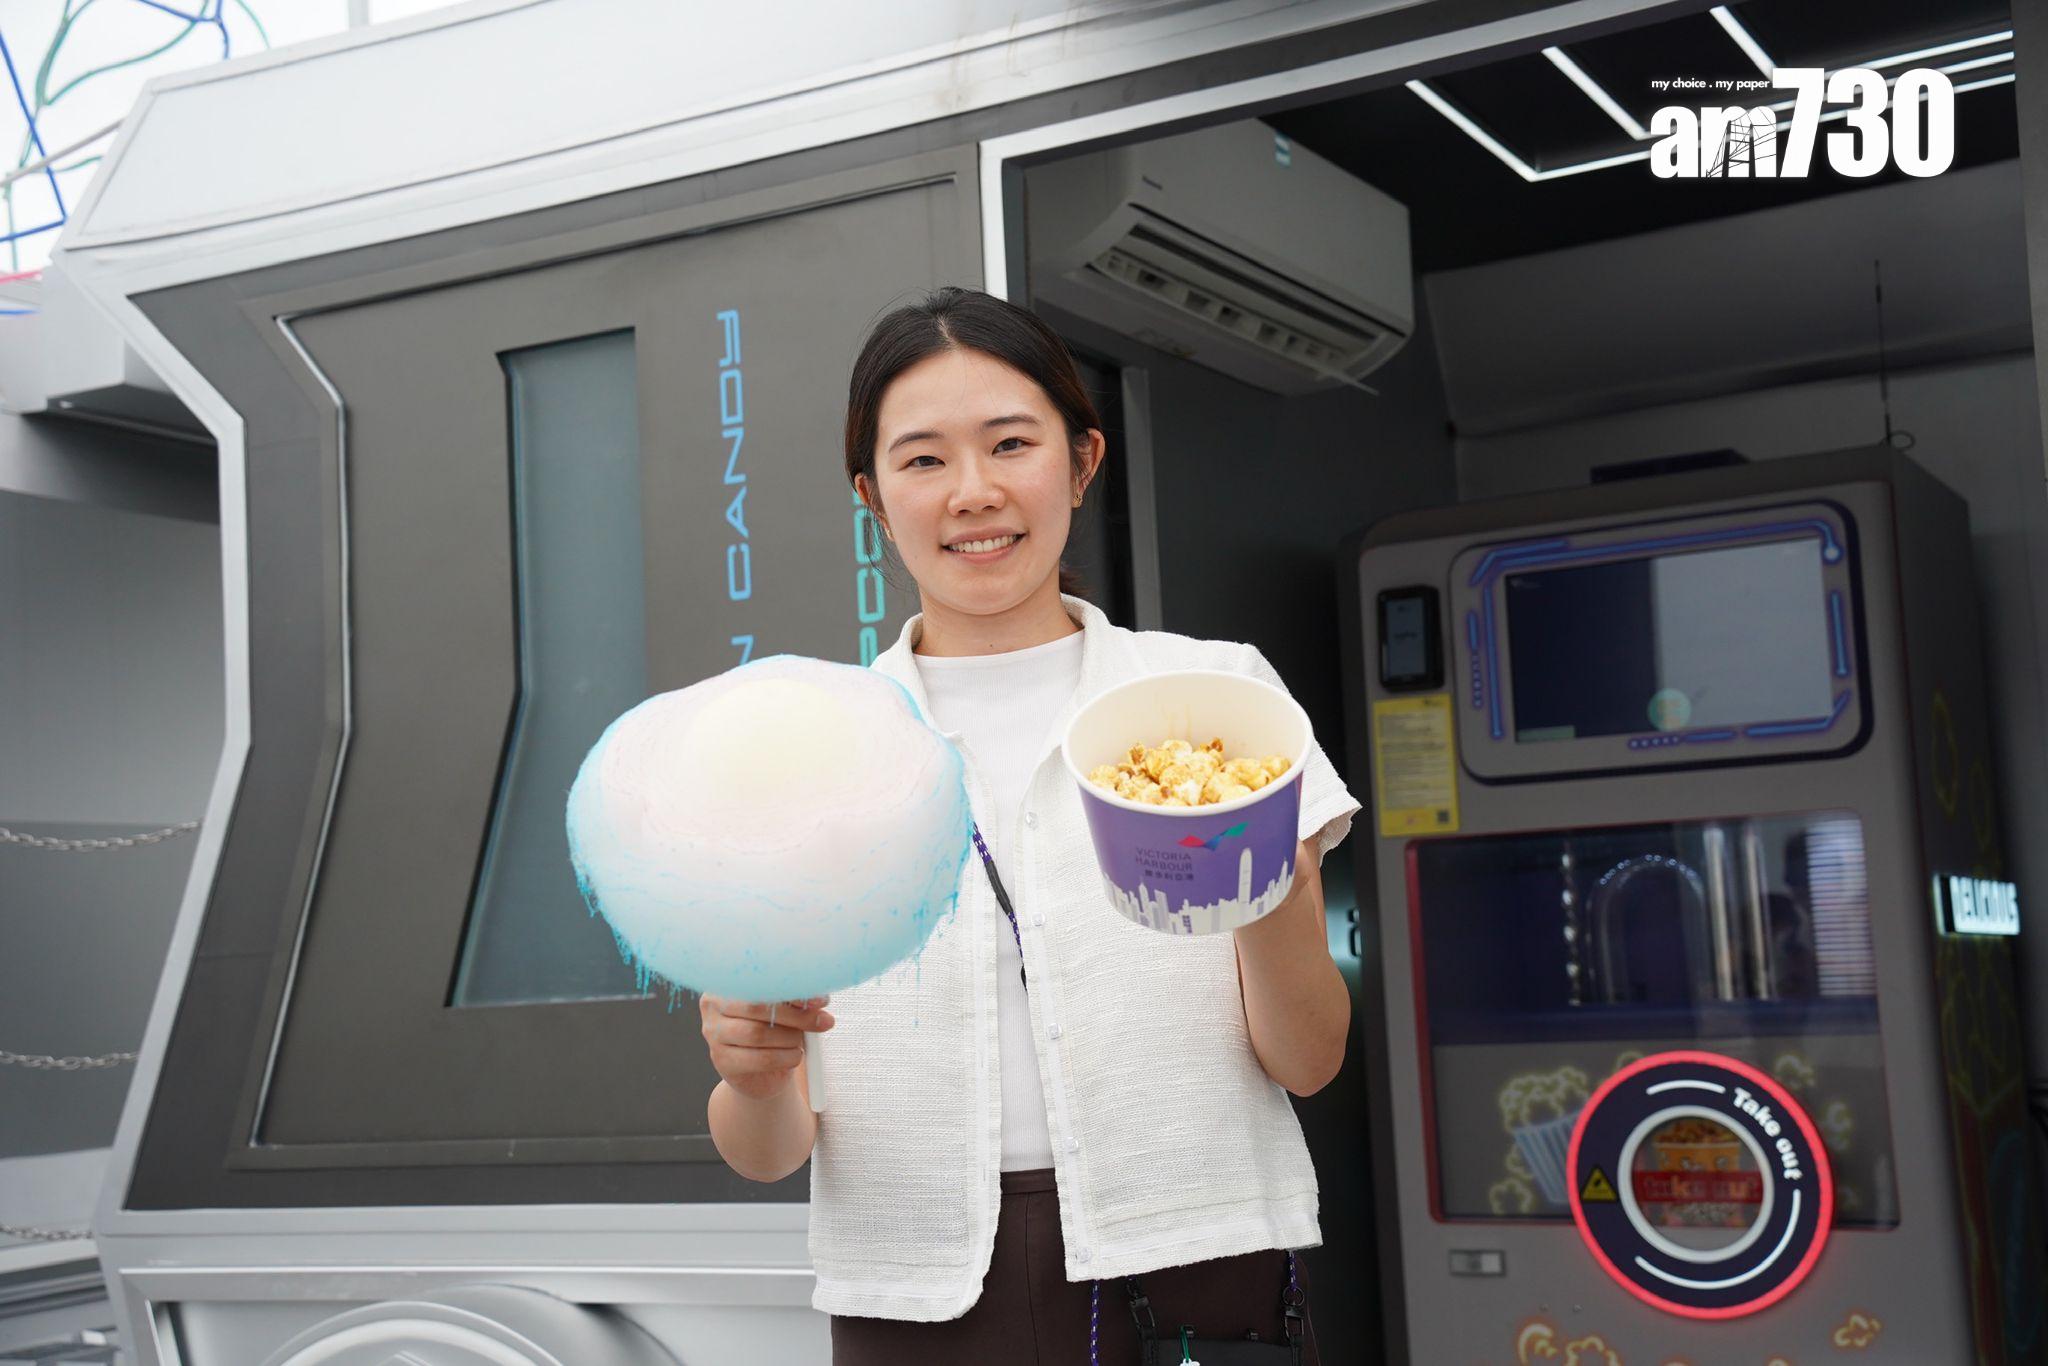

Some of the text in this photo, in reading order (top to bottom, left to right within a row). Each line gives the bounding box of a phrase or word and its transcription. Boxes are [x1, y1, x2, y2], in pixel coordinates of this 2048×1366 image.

[716, 309, 752, 601] CANDY
[1135, 847, 1192, 861] VICTORIA
[1135, 857, 1193, 872] HARBOUR
[1733, 1087, 1803, 1180] Take out
